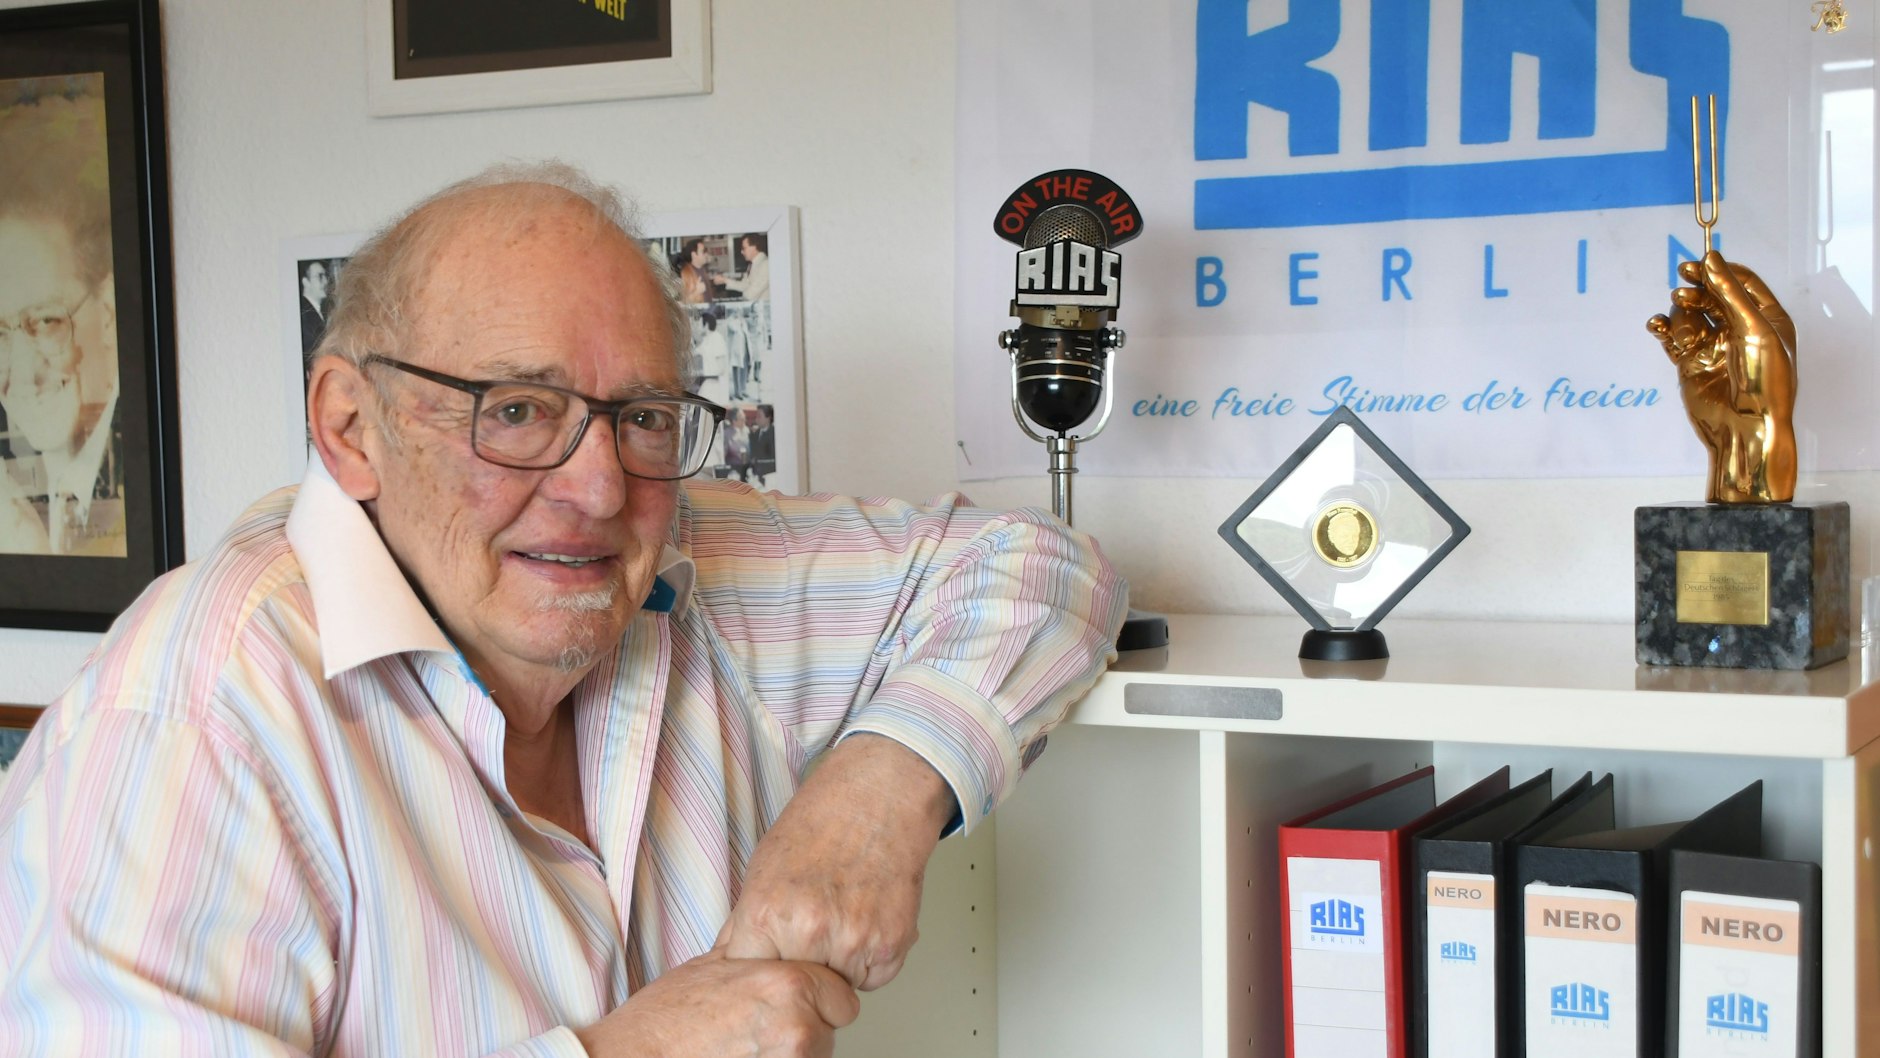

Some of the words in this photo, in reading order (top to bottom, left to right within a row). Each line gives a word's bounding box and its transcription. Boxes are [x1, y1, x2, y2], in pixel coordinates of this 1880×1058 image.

[1001, 192, 1038, 234] ON
[1035, 176, 1093, 201] THE
[1096, 190, 1135, 235] AIR
[1017, 241, 1119, 307] RIAS
[1195, 232, 1722, 307] BERLIN
[1132, 394, 1199, 417] eine
[1211, 386, 1295, 421] freie
[1307, 375, 1449, 417] Stimme
[1462, 379, 1531, 415] der
[1543, 376, 1662, 413] freien
[1434, 886, 1482, 900] NERO
[1310, 898, 1365, 936] RIAS
[1543, 908, 1622, 932] NERO
[1701, 916, 1783, 942] NERO
[1310, 934, 1365, 945] BERLIN
[1440, 940, 1476, 961] RIAS
[1550, 982, 1609, 1021] RIAS
[1706, 992, 1768, 1033] RIAS
